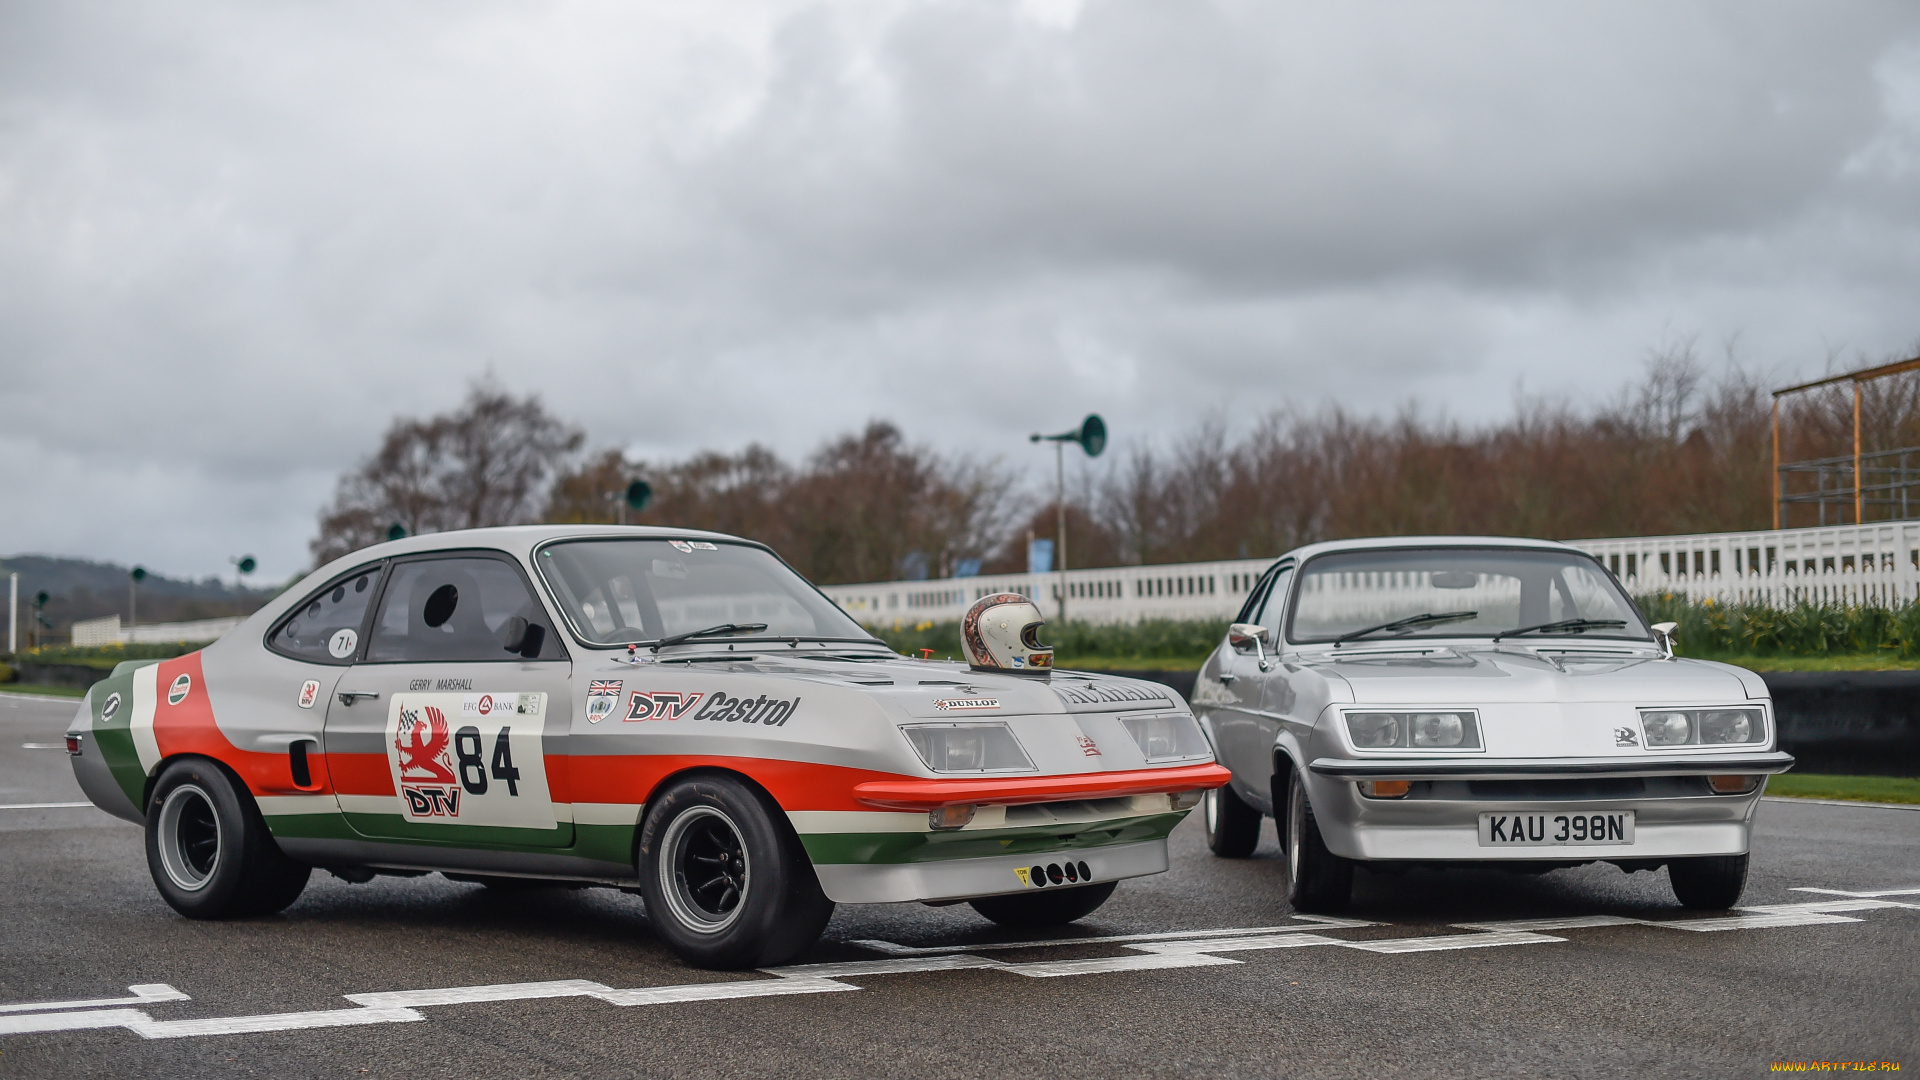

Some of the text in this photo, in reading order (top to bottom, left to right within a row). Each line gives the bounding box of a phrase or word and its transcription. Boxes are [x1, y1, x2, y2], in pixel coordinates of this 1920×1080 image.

[409, 678, 473, 691] GERRY MARSHALL
[463, 702, 514, 711] EFG BANK
[625, 692, 801, 727] DTV Castrol
[948, 699, 998, 708] DUNLOP
[454, 725, 521, 797] 84
[402, 786, 461, 816] DTV
[1490, 814, 1624, 842] KAU 398N
